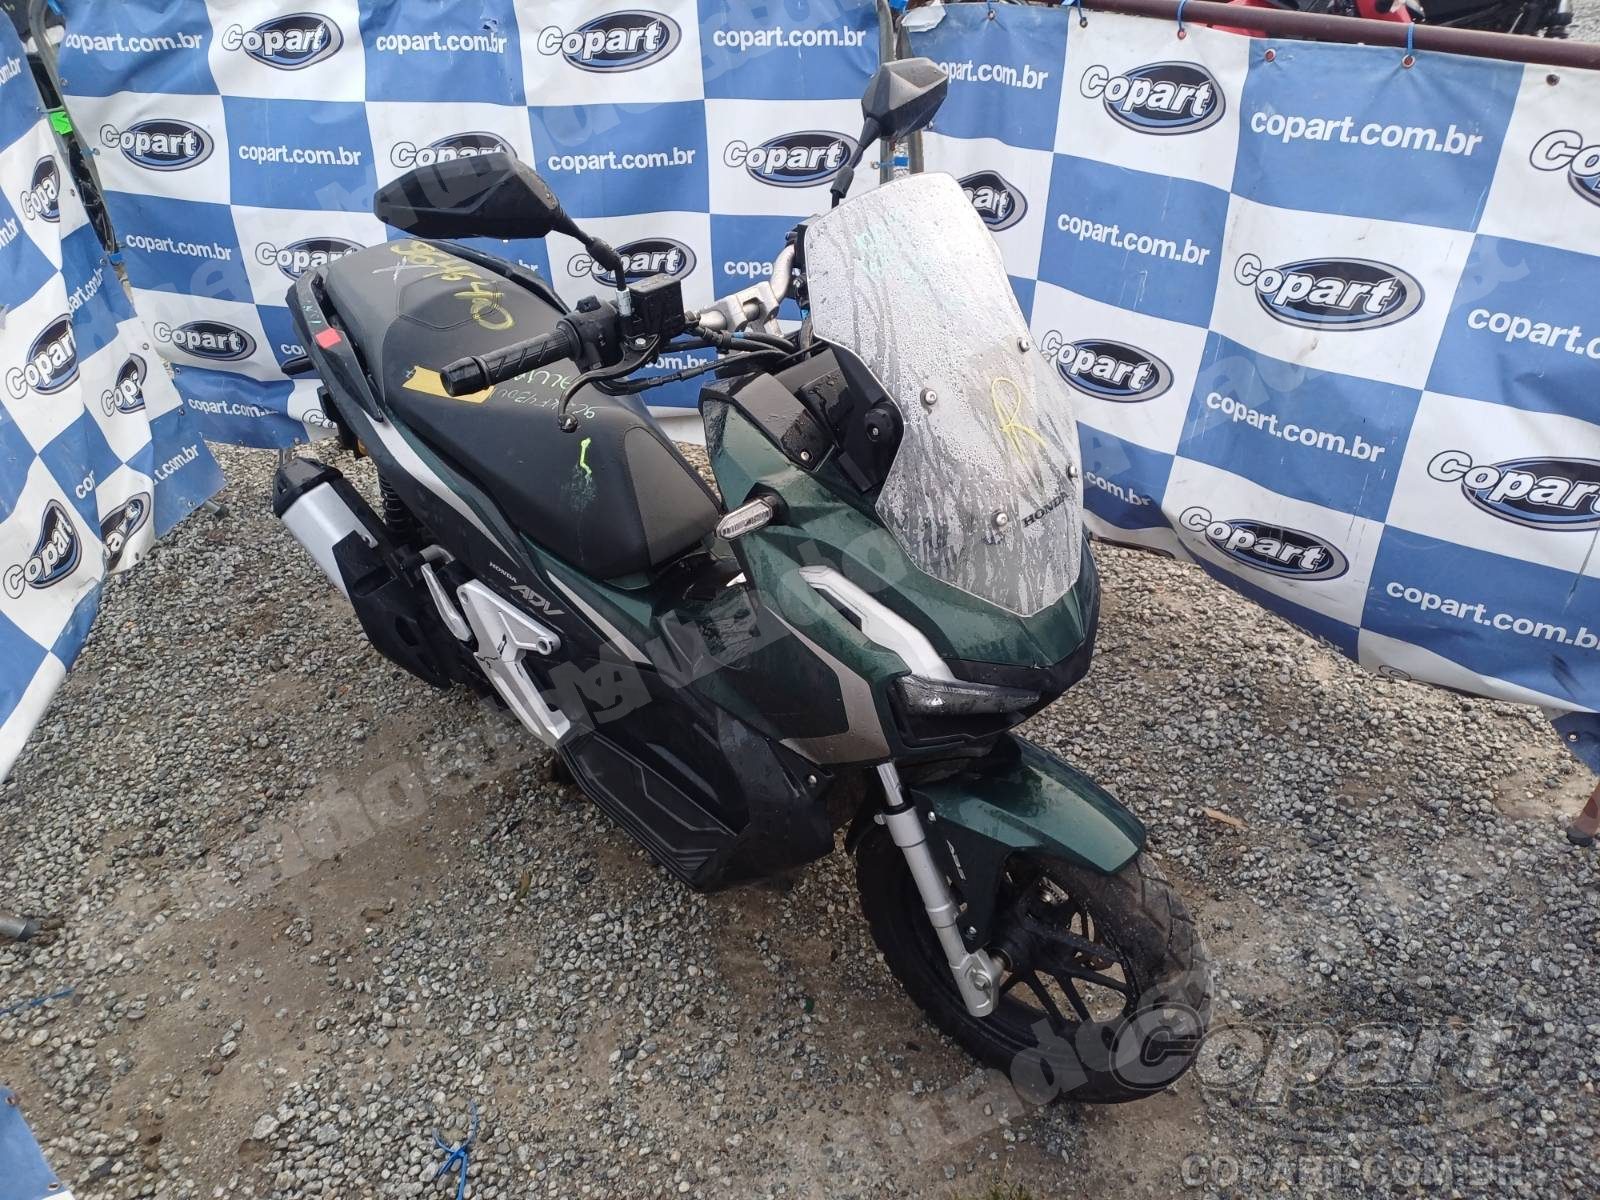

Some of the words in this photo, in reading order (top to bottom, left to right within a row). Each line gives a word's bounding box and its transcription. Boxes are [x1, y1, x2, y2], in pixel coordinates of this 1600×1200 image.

[65, 31, 203, 53] copart.com.br
[222, 22, 327, 57] Copart
[537, 18, 662, 60] Copart
[713, 26, 867, 50] copart.com.br
[1080, 65, 1210, 118] Copart
[100, 124, 197, 157] Copart
[1251, 111, 1483, 157] copart.com.br
[238, 145, 362, 166] copart.com.br
[548, 147, 695, 174] copart.com.br
[724, 140, 844, 175] Copart
[126, 234, 231, 261] copart.com.br
[1057, 212, 1210, 265] copart.com.br
[1233, 253, 1399, 315] Copart
[153, 322, 242, 352] Copart
[6, 321, 77, 400] Copar
[1041, 329, 1153, 391] Copart
[1206, 391, 1386, 464] copart.com.br
[1021, 491, 1069, 528] HONDA
[1179, 506, 1328, 572] Copart
[489, 561, 518, 583] HONDA
[509, 584, 565, 615] ADV
